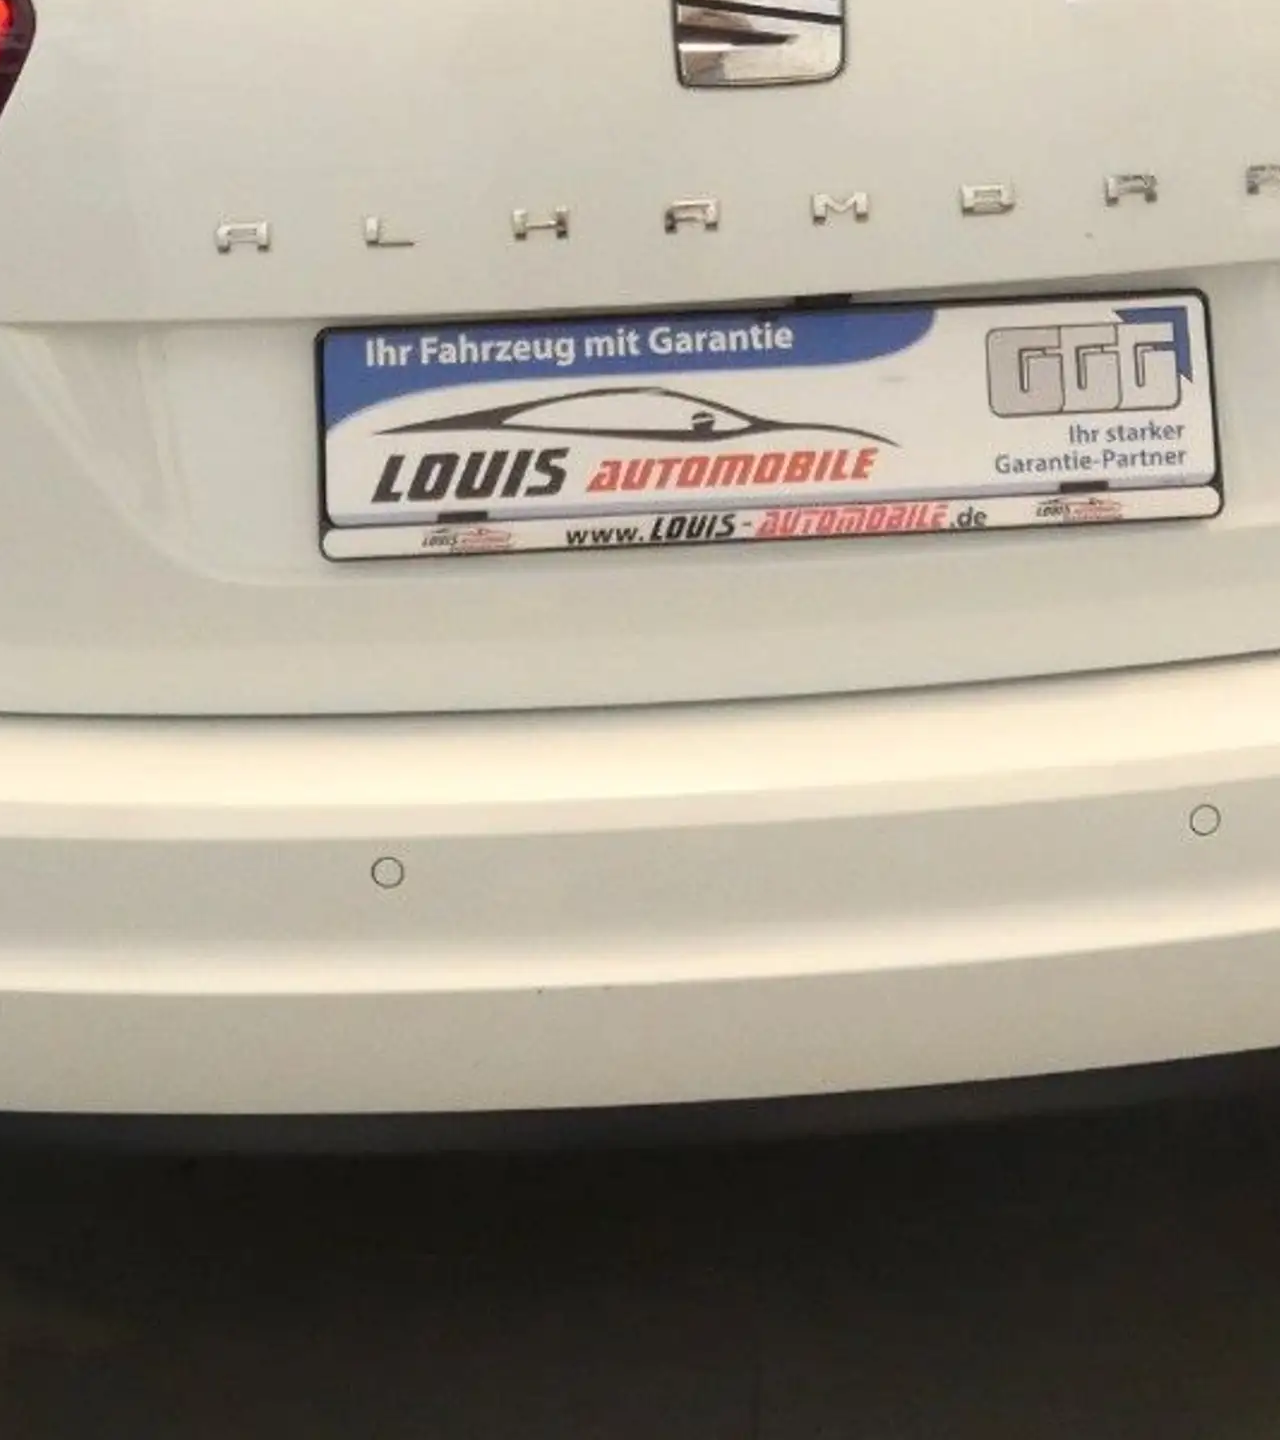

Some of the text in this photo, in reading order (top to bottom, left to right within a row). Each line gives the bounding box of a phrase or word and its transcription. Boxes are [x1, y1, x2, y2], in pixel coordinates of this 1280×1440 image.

[365, 322, 795, 368] Ihr Fahrzeug mit Garantie
[1069, 419, 1186, 445] Ihr starker
[370, 446, 879, 503] LOUIS AUTOMOBILE
[994, 447, 1187, 475] Garantie-Partner
